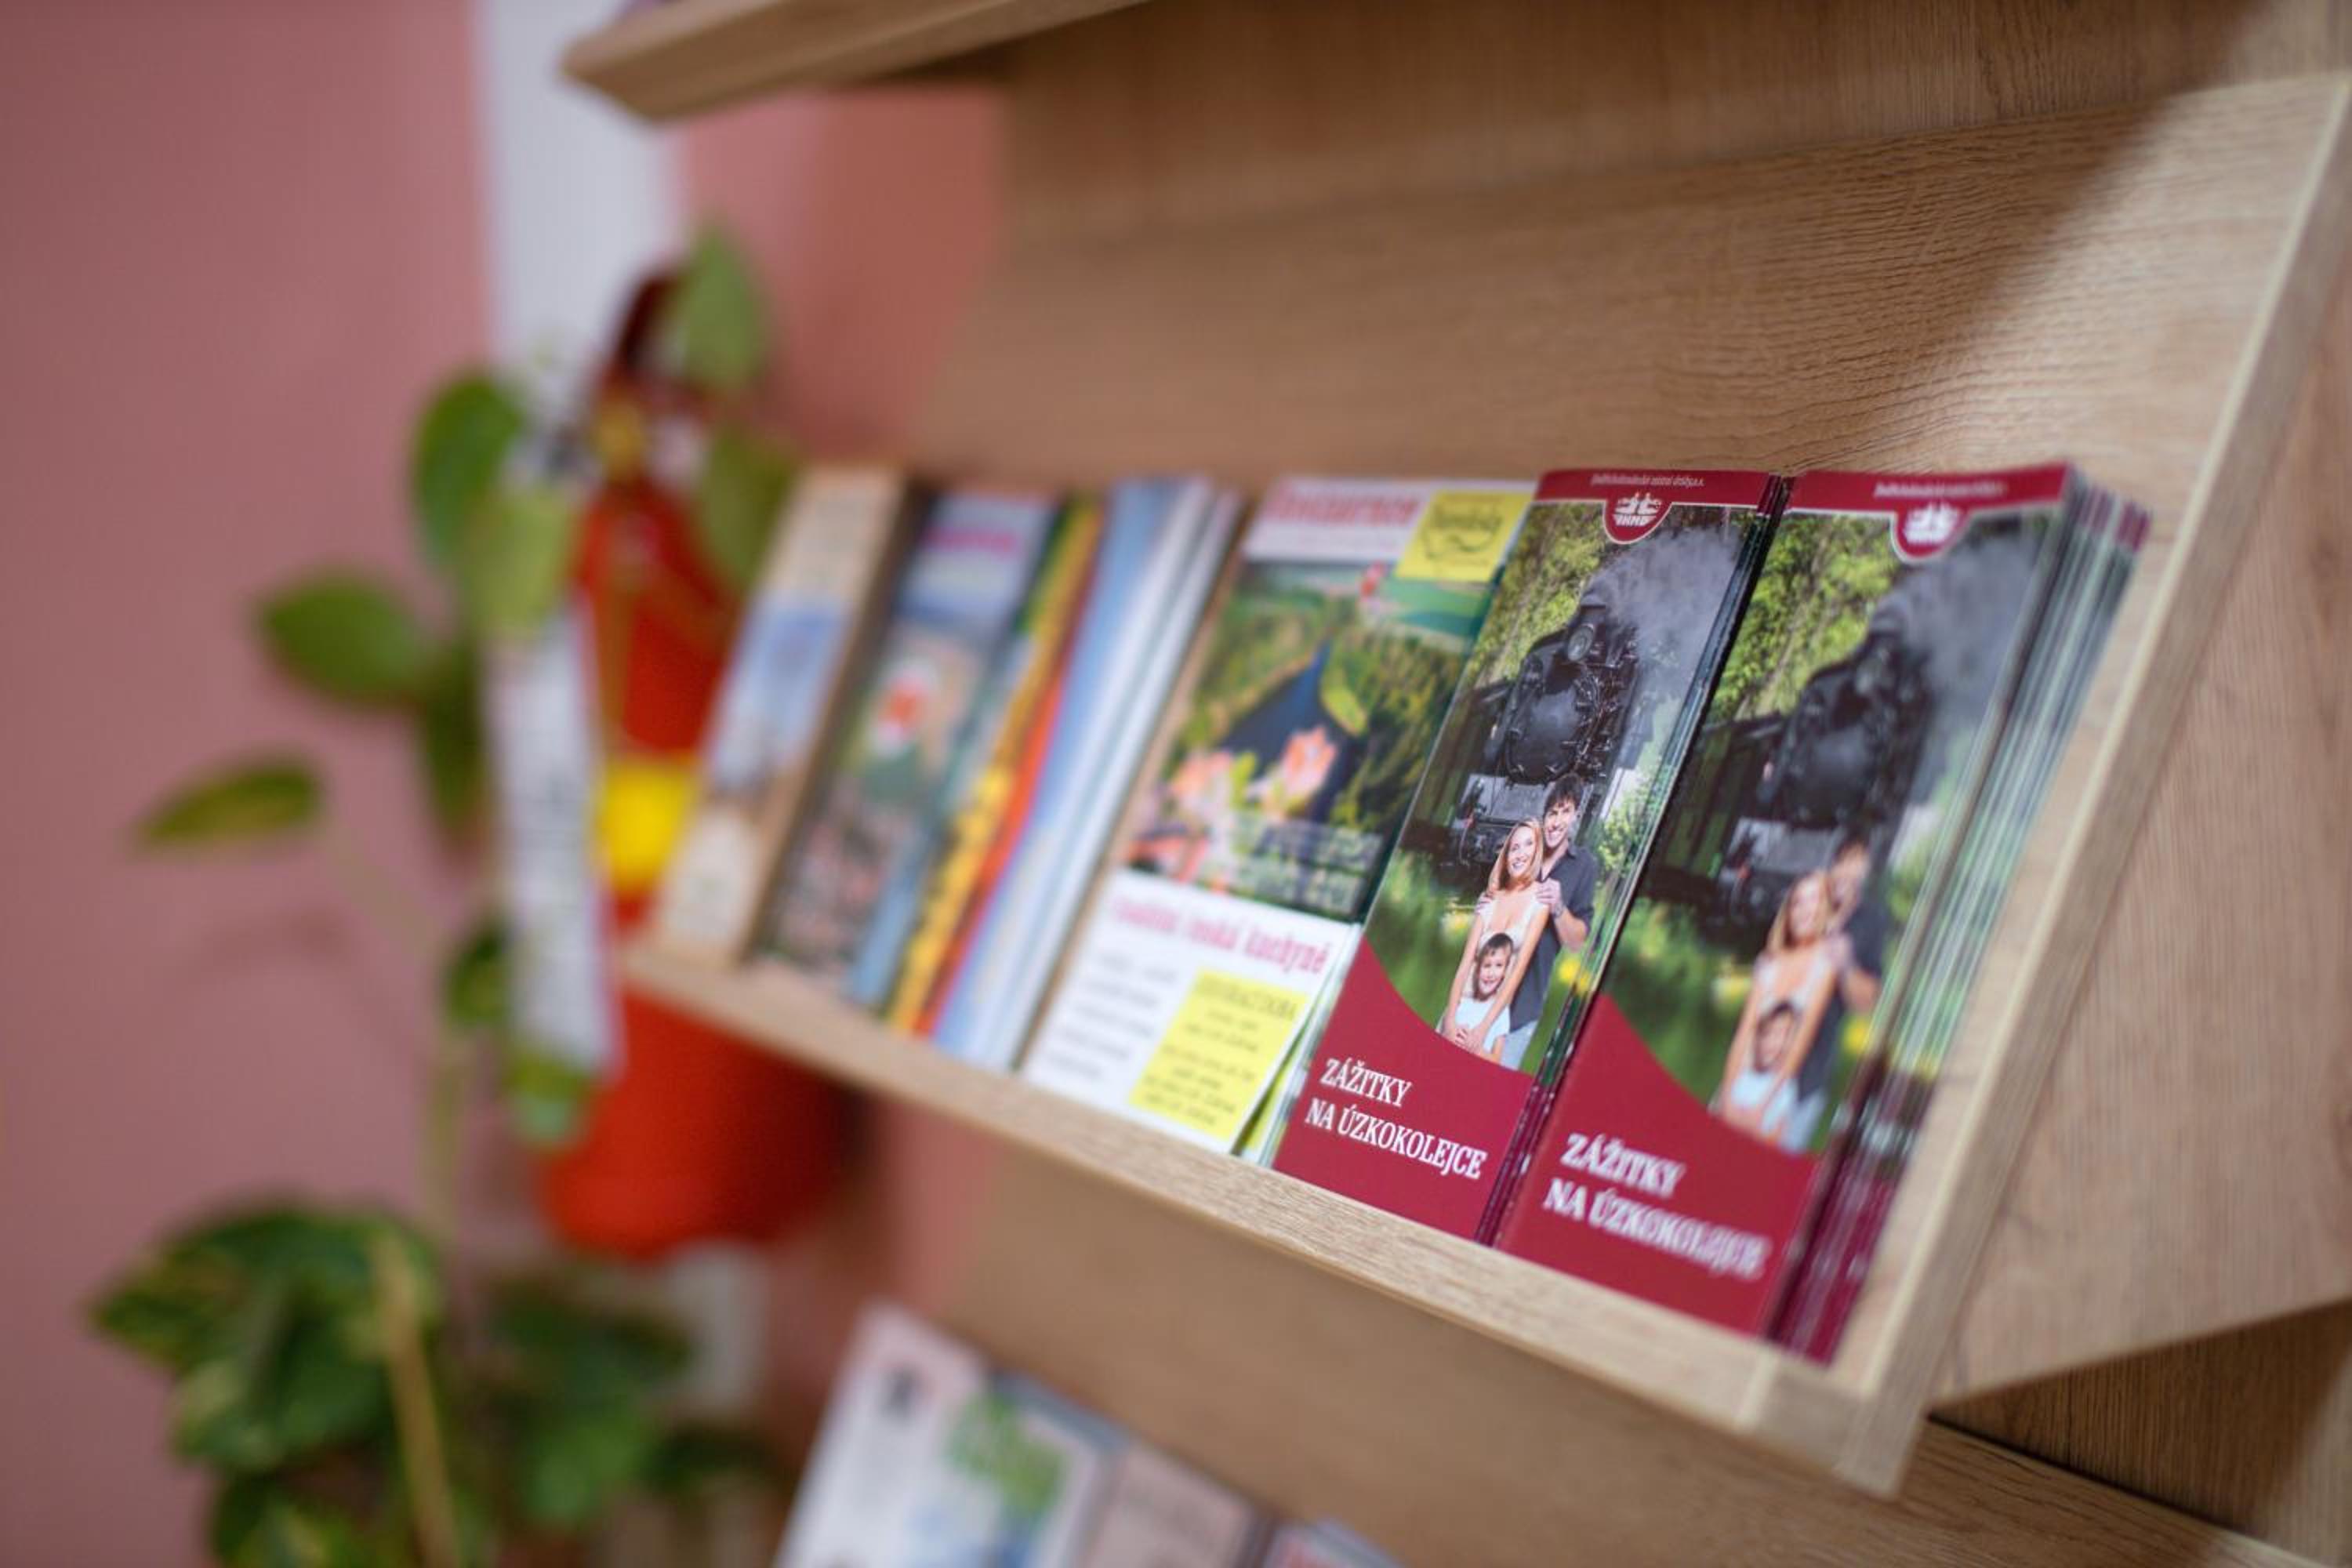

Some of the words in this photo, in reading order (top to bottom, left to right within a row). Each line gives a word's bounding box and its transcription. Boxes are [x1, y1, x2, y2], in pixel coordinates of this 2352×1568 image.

[1320, 1057, 1412, 1108] ZÁŽITKY
[1305, 1098, 1336, 1131] NA
[1338, 1104, 1487, 1179] ÚZKOKOLEJCE
[1560, 1133, 1686, 1199] ZÁŽITKY
[1542, 1178, 1588, 1221] NA
[1588, 1188, 1772, 1280] ÚZKOKOLEJCE
